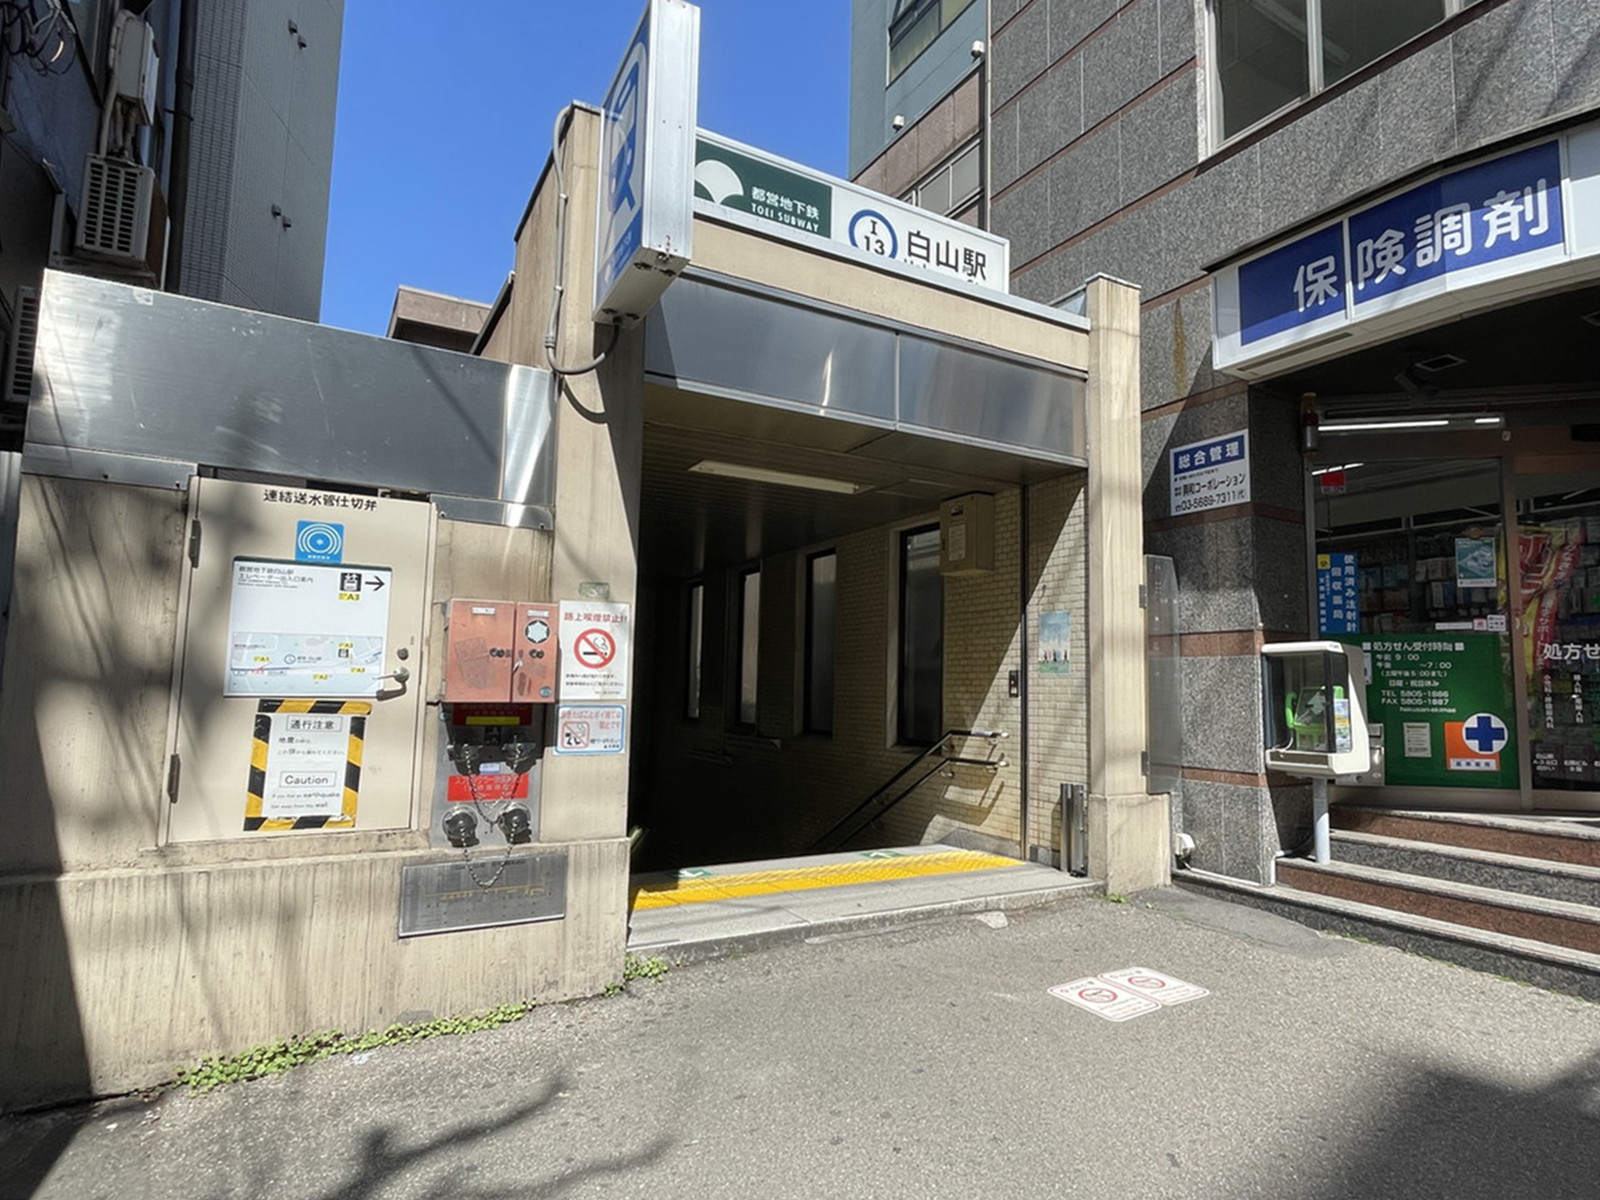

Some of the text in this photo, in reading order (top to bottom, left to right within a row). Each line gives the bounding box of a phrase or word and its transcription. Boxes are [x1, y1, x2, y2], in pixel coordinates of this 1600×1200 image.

[752, 186, 819, 220] 都営地下鉄
[751, 203, 819, 232] TOEI SUBWAY
[864, 235, 885, 256] 13
[908, 230, 986, 281] 白山駅
[1293, 178, 1549, 313] 保険調剤
[1178, 441, 1239, 470] 総合管理
[263, 489, 378, 511] 連結送水管仕切弁
[1544, 643, 1600, 660] 処方せ
[290, 719, 334, 730] 通行注意
[285, 775, 329, 785] Caution
